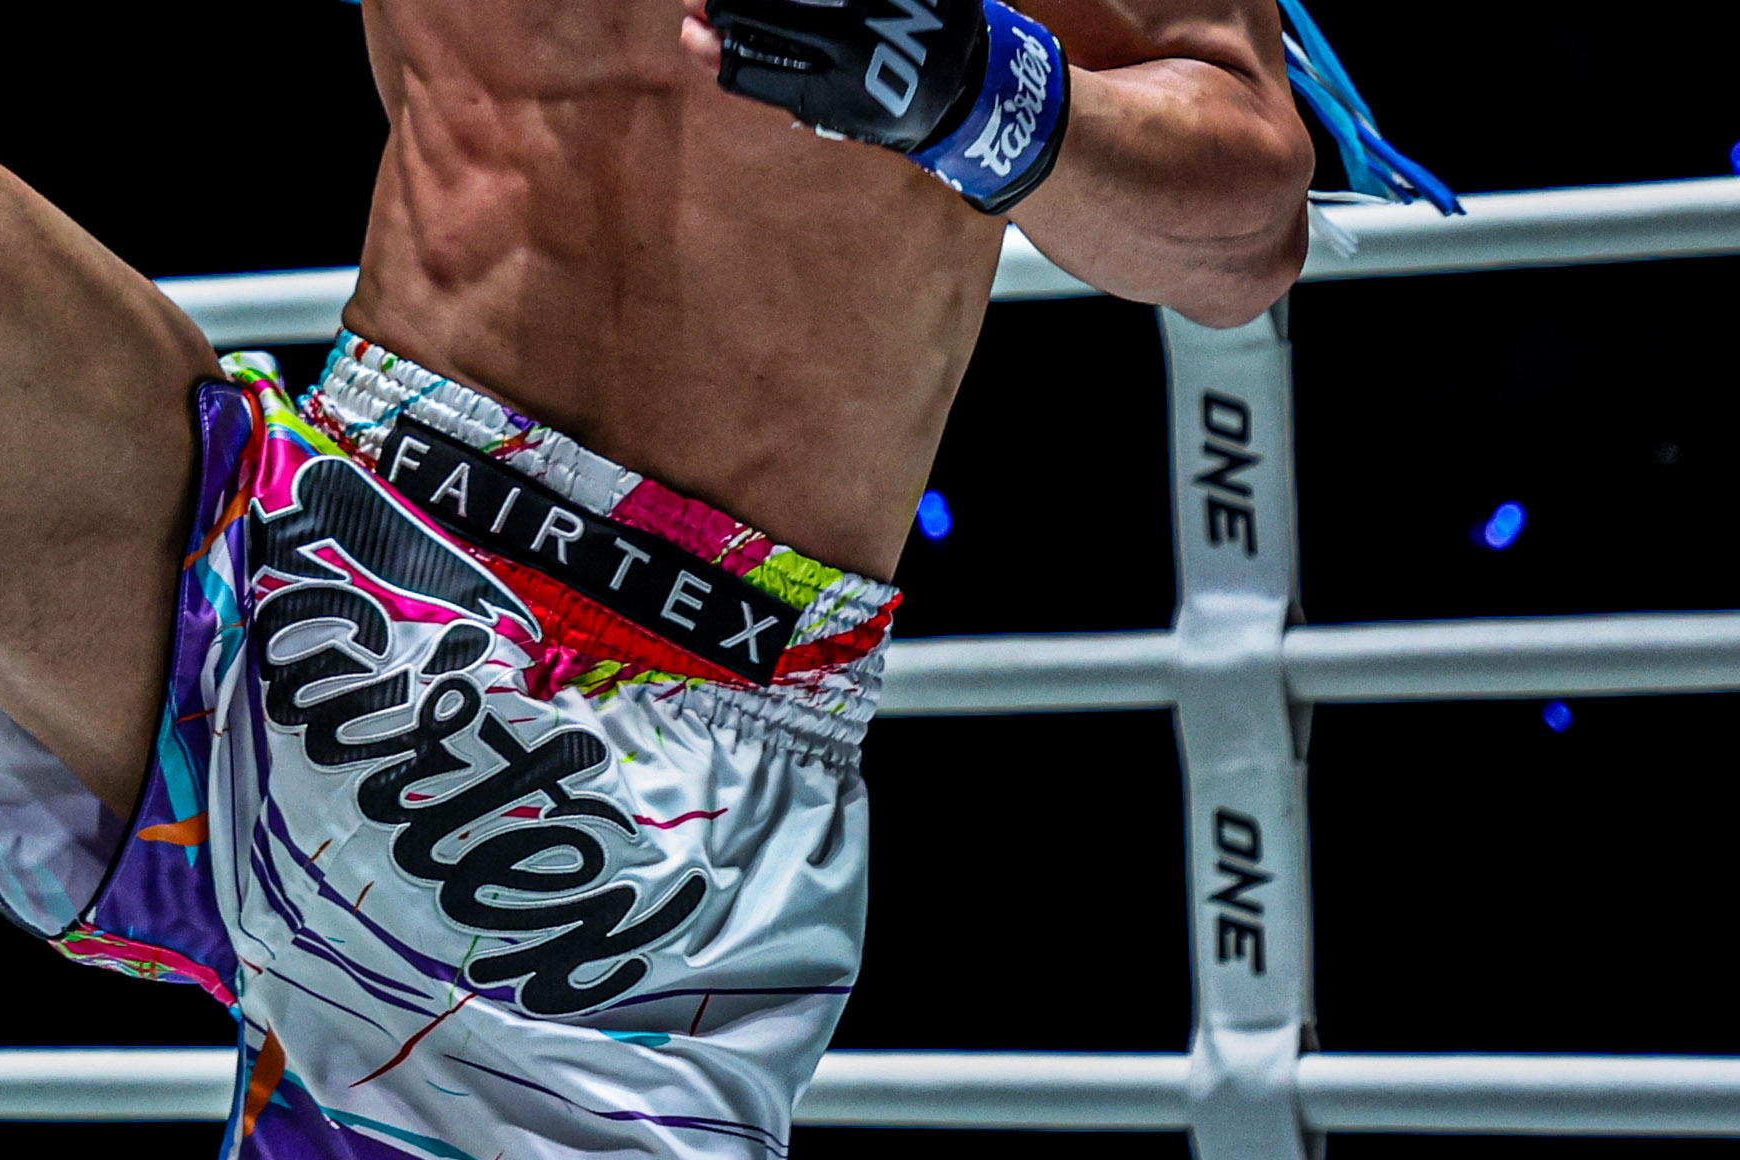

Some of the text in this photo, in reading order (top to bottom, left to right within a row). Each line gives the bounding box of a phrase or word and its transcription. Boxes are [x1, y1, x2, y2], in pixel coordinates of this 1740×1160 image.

[964, 26, 1050, 177] Fairtex
[389, 434, 779, 664] FAIRTEX
[1192, 387, 1265, 560] ONE
[250, 454, 712, 1018] Fairtex
[1205, 806, 1278, 977] ONE
